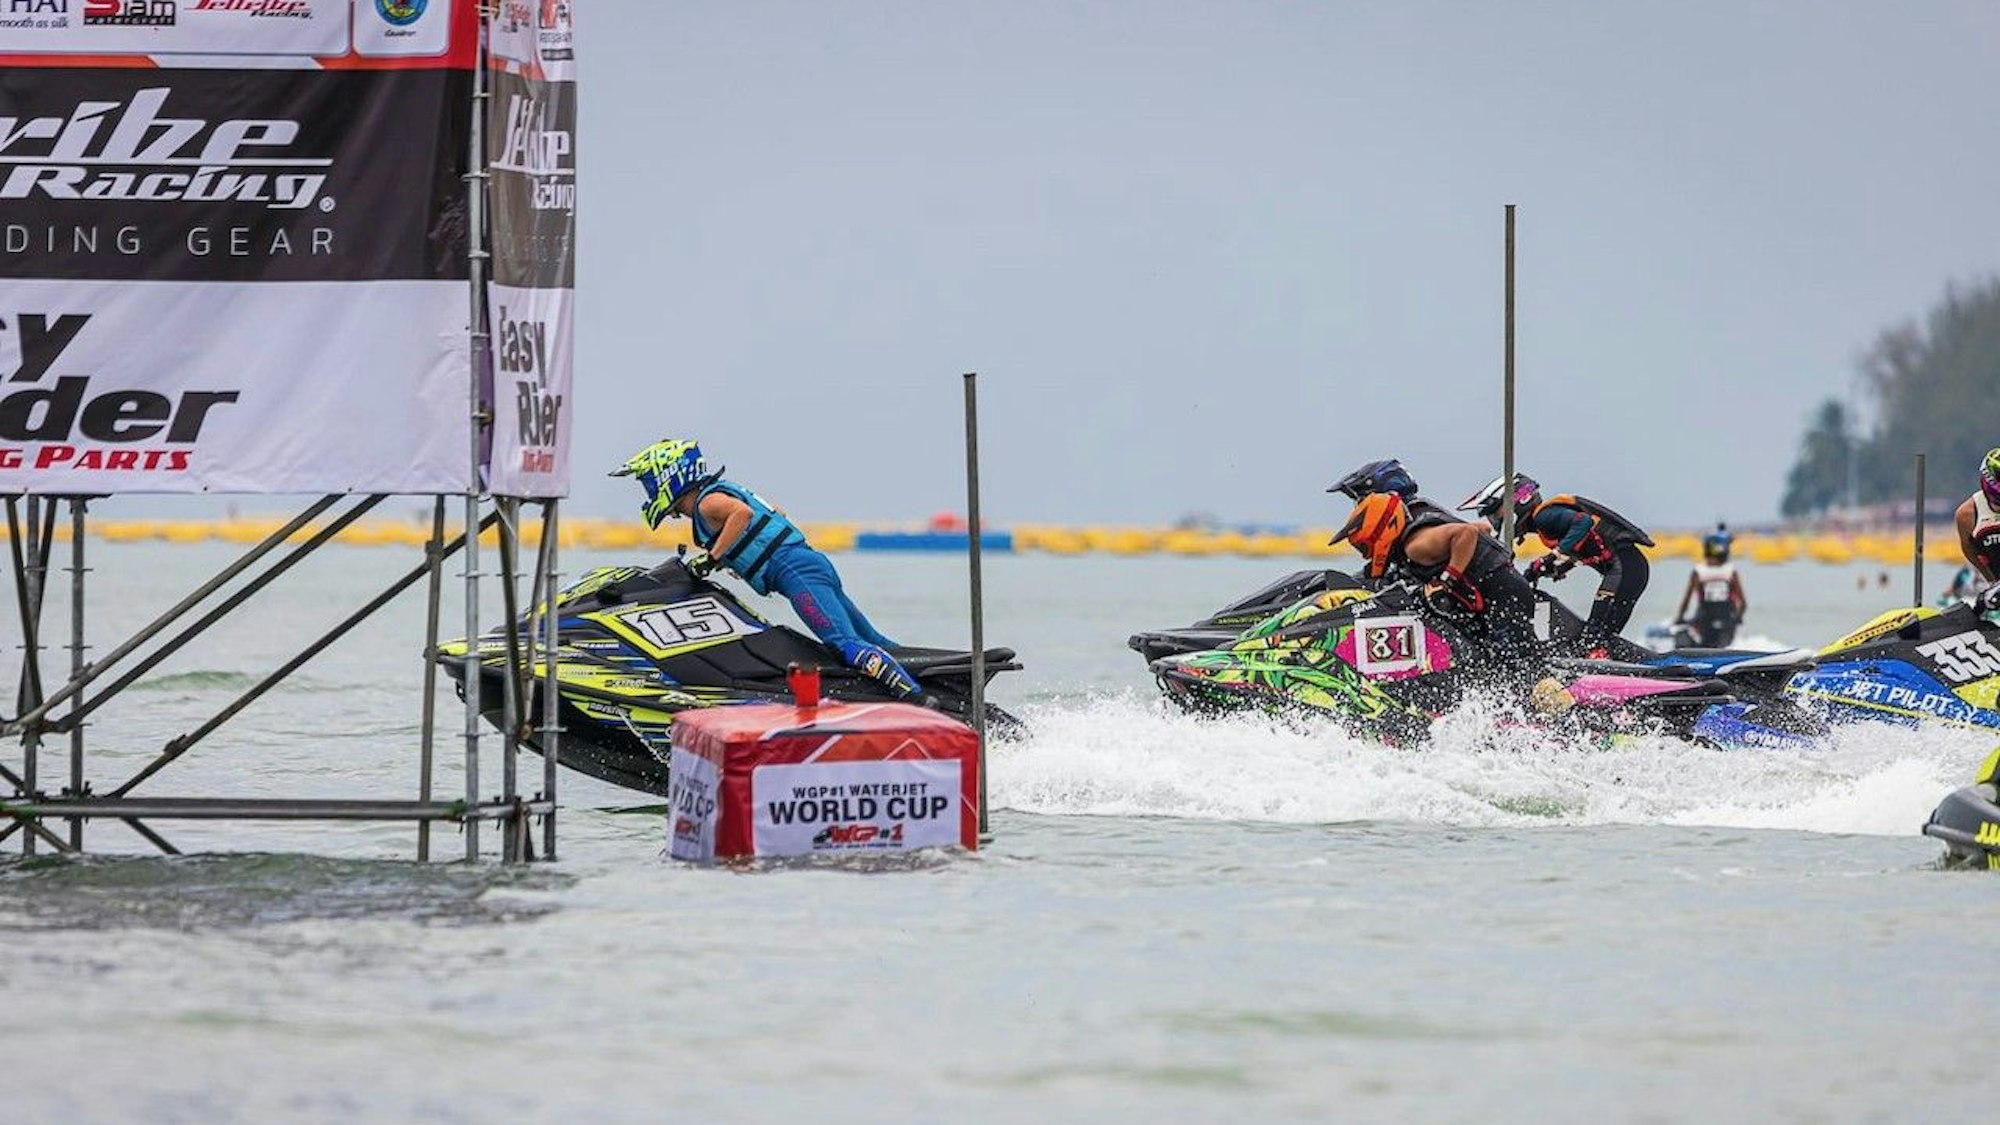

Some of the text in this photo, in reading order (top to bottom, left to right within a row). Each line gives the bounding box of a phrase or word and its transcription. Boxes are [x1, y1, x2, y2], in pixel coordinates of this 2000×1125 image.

[51, 17, 69, 28] silk
[6, 225, 333, 256] DING GEAR
[638, 600, 734, 646] 15
[1369, 627, 1409, 658] 81
[1914, 629, 2000, 683] 333
[1842, 680, 1955, 716] JET PILOT
[792, 783, 928, 798] WGP#1 WATERJET
[769, 796, 948, 824] WORLD CUP
